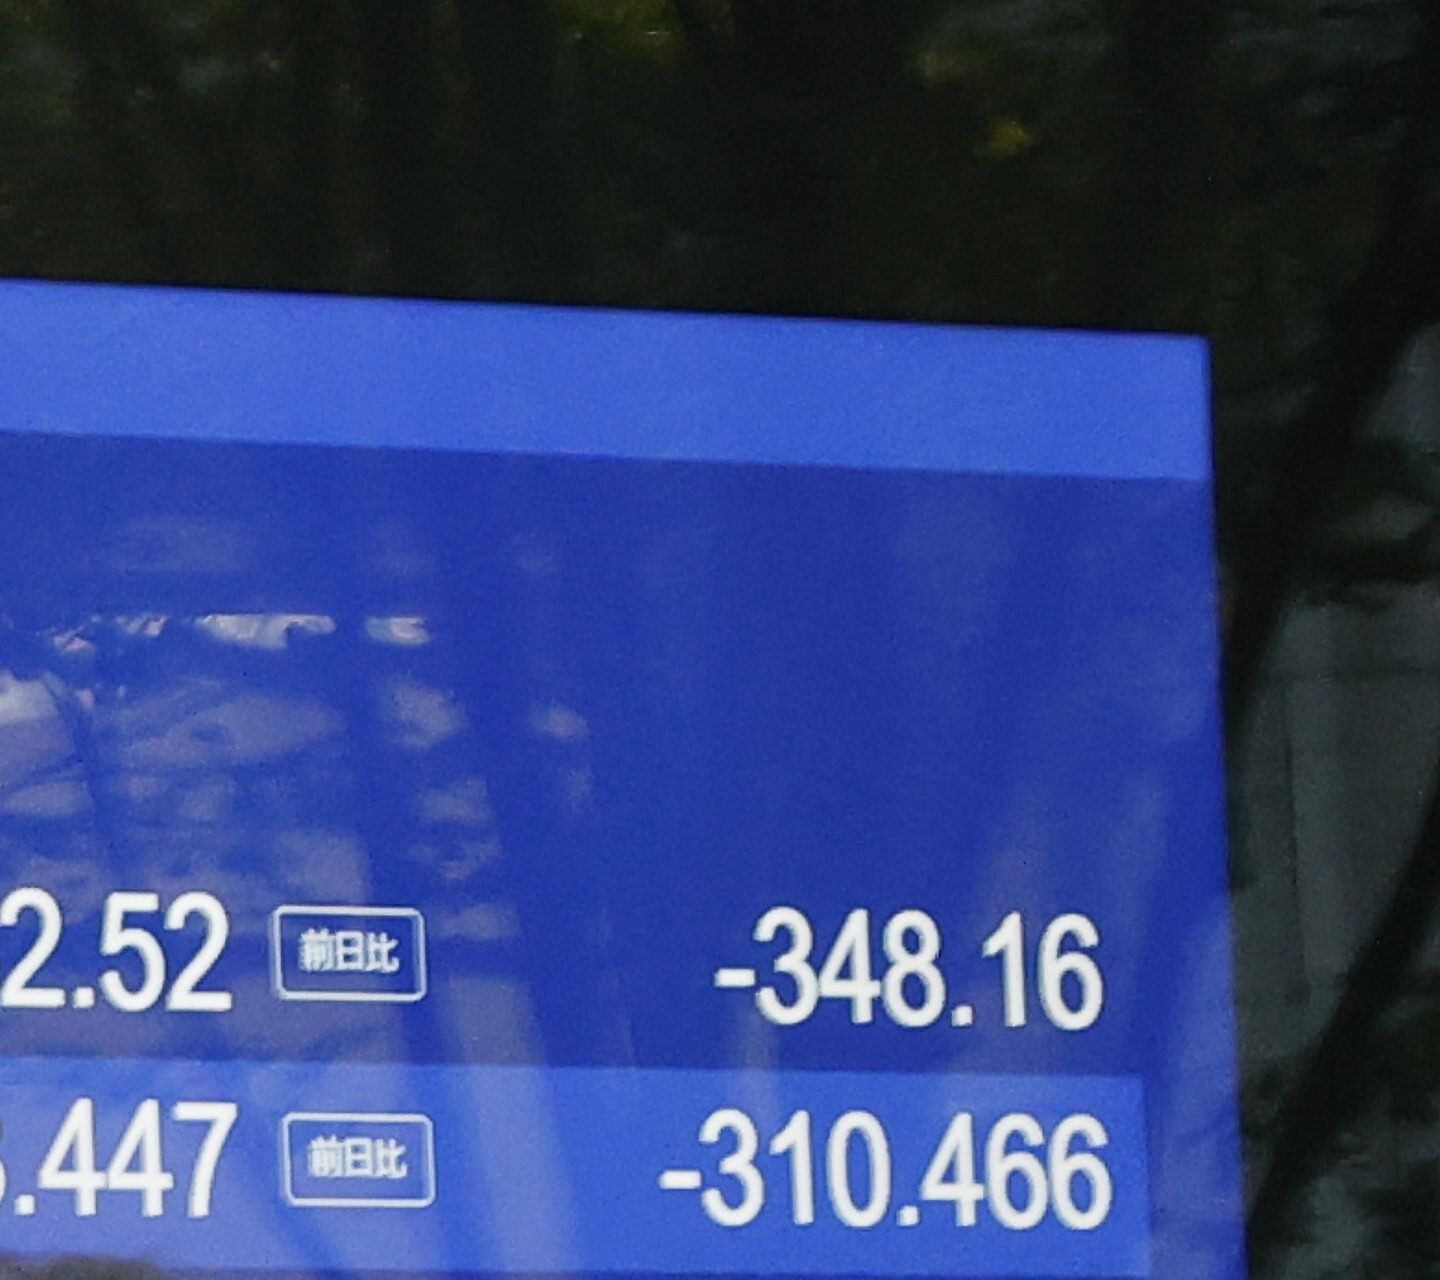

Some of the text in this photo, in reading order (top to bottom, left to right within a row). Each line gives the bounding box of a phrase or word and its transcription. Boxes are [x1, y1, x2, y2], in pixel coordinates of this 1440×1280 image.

[300, 928, 400, 973] 前日比
[715, 906, 1103, 1031] -348.16
[311, 1135, 408, 1179] 前日比
[659, 1108, 1113, 1231] -310.466
